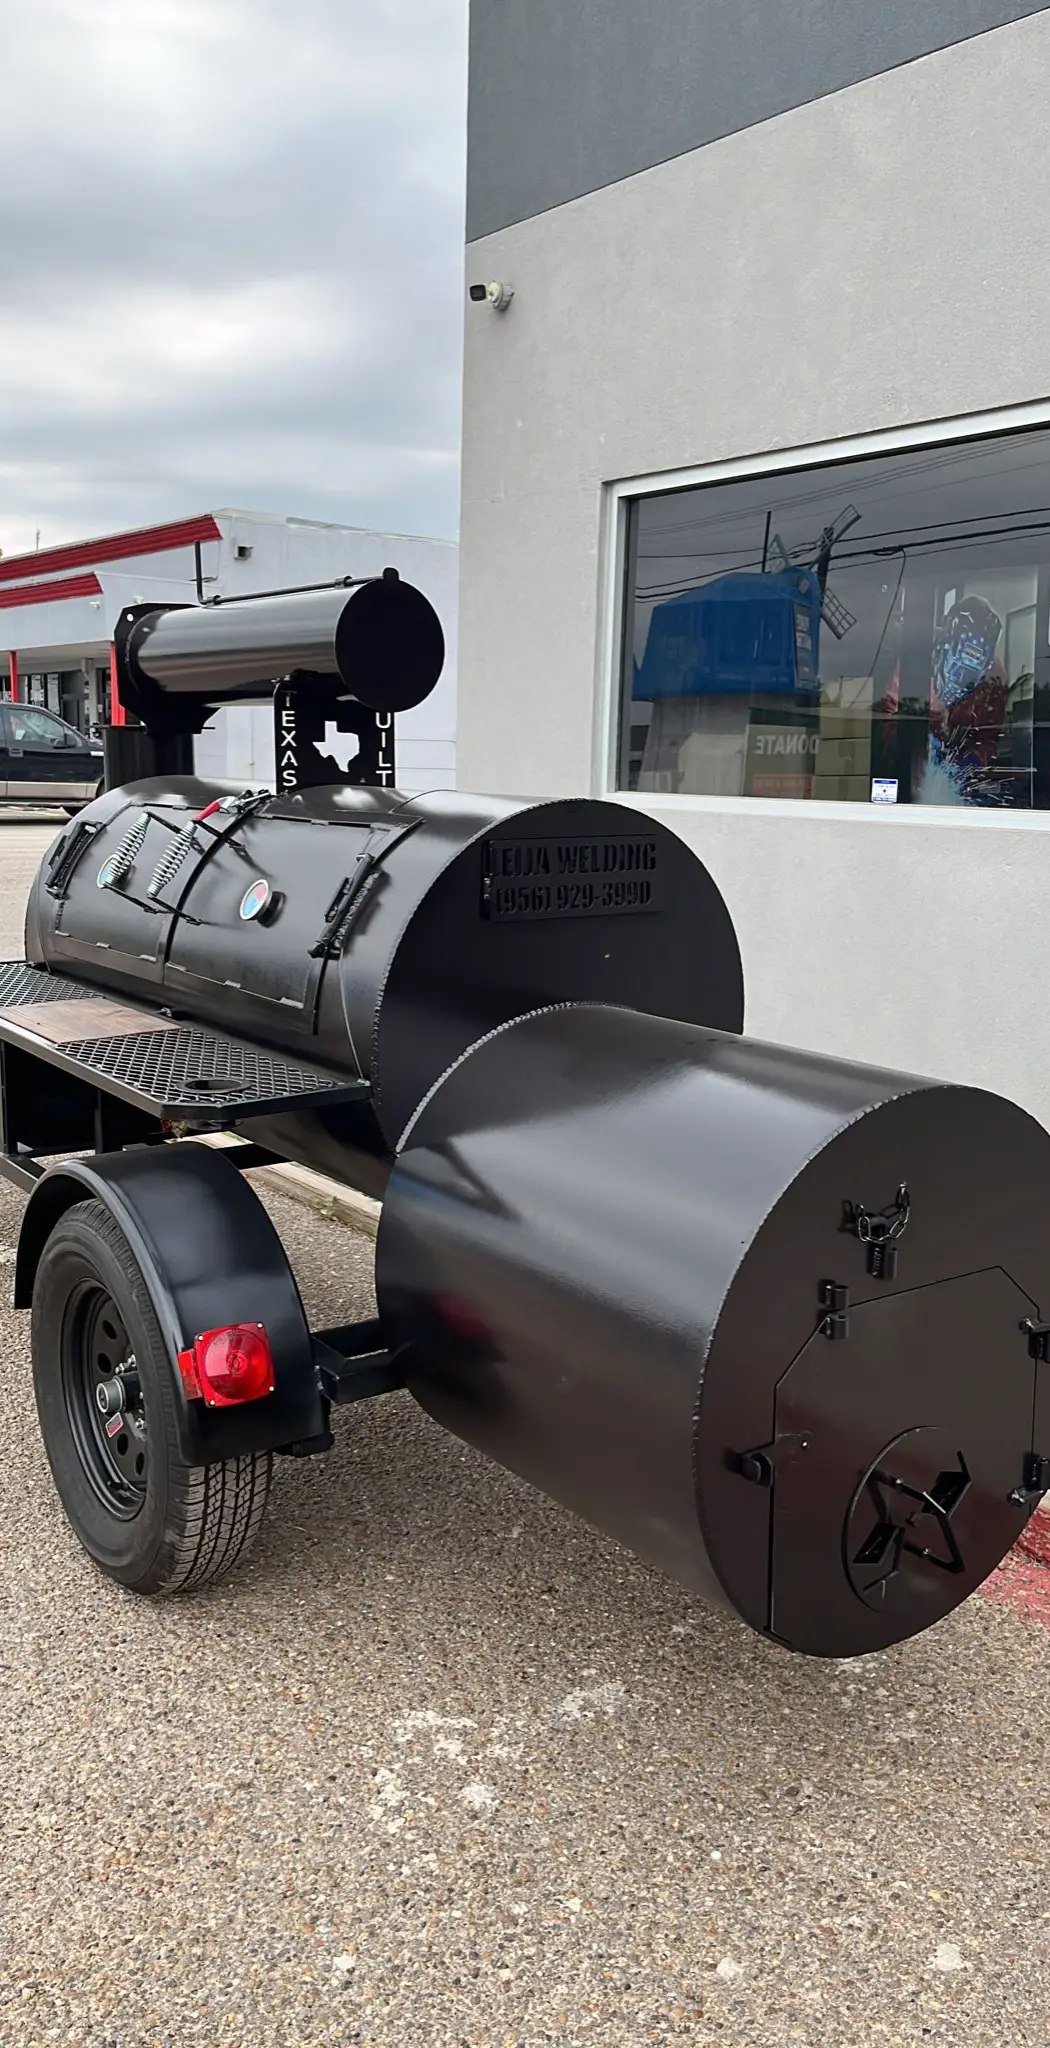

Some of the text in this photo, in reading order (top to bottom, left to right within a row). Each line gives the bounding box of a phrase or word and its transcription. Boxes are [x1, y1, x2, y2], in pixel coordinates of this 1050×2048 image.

[279, 691, 299, 787] TEXAS
[375, 711, 393, 787] UILT
[557, 842, 657, 875] WELDING
[496, 880, 652, 914] (956) 929-3990
